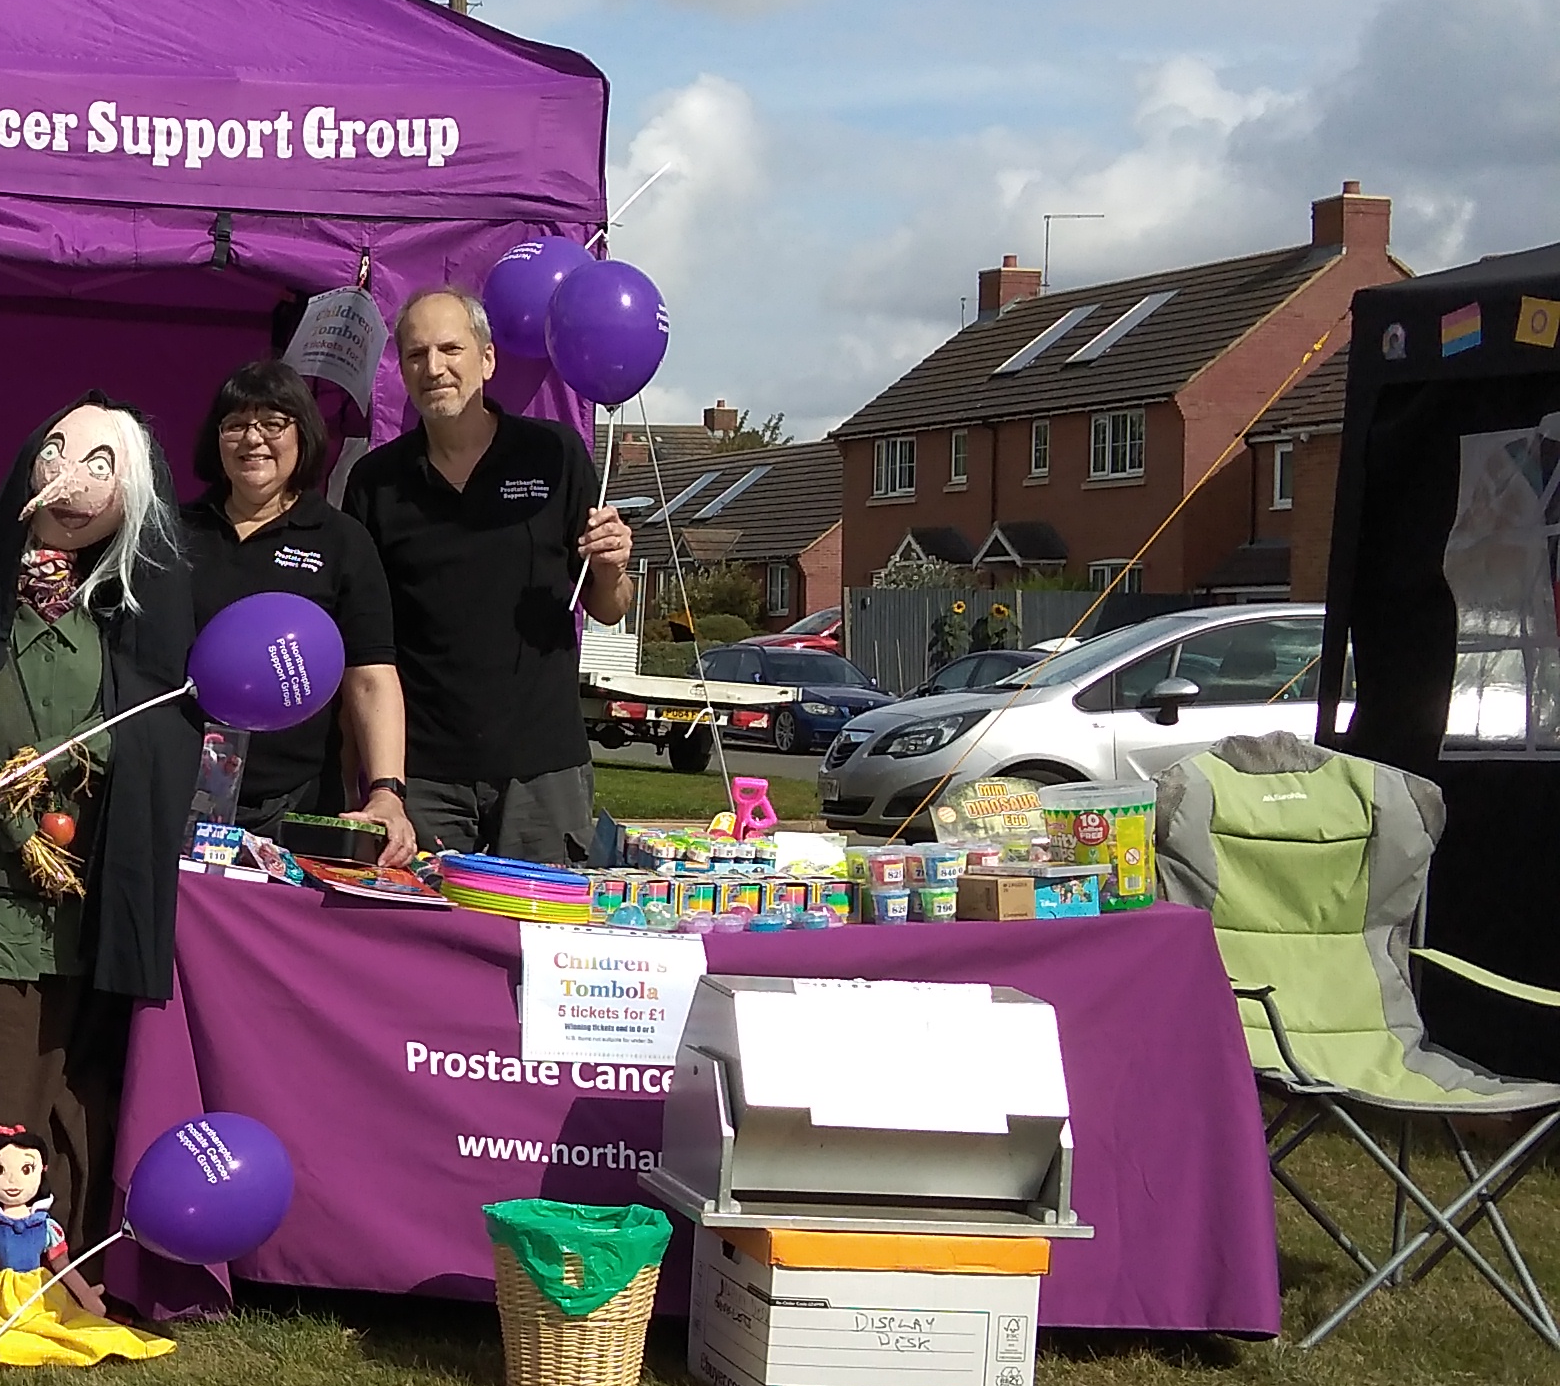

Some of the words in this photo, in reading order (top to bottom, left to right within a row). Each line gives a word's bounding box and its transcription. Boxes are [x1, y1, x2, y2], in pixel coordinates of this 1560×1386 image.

[87, 100, 293, 168] Support
[302, 106, 460, 167] Group
[268, 645, 286, 681] Support
[280, 681, 291, 707] Group
[276, 638, 295, 676] Prostate
[291, 677, 302, 705] Cancer
[289, 641, 311, 696] Northampton
[978, 783, 1008, 796] MINI
[965, 793, 1041, 817] DINOSAUR
[1003, 813, 1028, 826] EGG
[1080, 814, 1100, 827] 10
[1051, 833, 1077, 849] uity
[209, 852, 226, 860] 110
[553, 951, 667, 973] Childrens
[560, 979, 659, 1000] Tombola
[558, 1005, 566, 1018] 5
[571, 1005, 619, 1020] tickets
[624, 1007, 646, 1021] for
[648, 1008, 666, 1021] £1
[565, 1023, 591, 1032] Winning
[593, 1024, 614, 1032] tickets
[406, 1041, 560, 1086] Prostate
[571, 1062, 675, 1094] Cance
[185, 1122, 209, 1148] Prostate
[206, 1147, 230, 1181] Cancer
[199, 1121, 237, 1166] Northampto
[457, 1134, 663, 1171] www.northa
[176, 1130, 200, 1156] Support
[197, 1154, 217, 1184] Group
